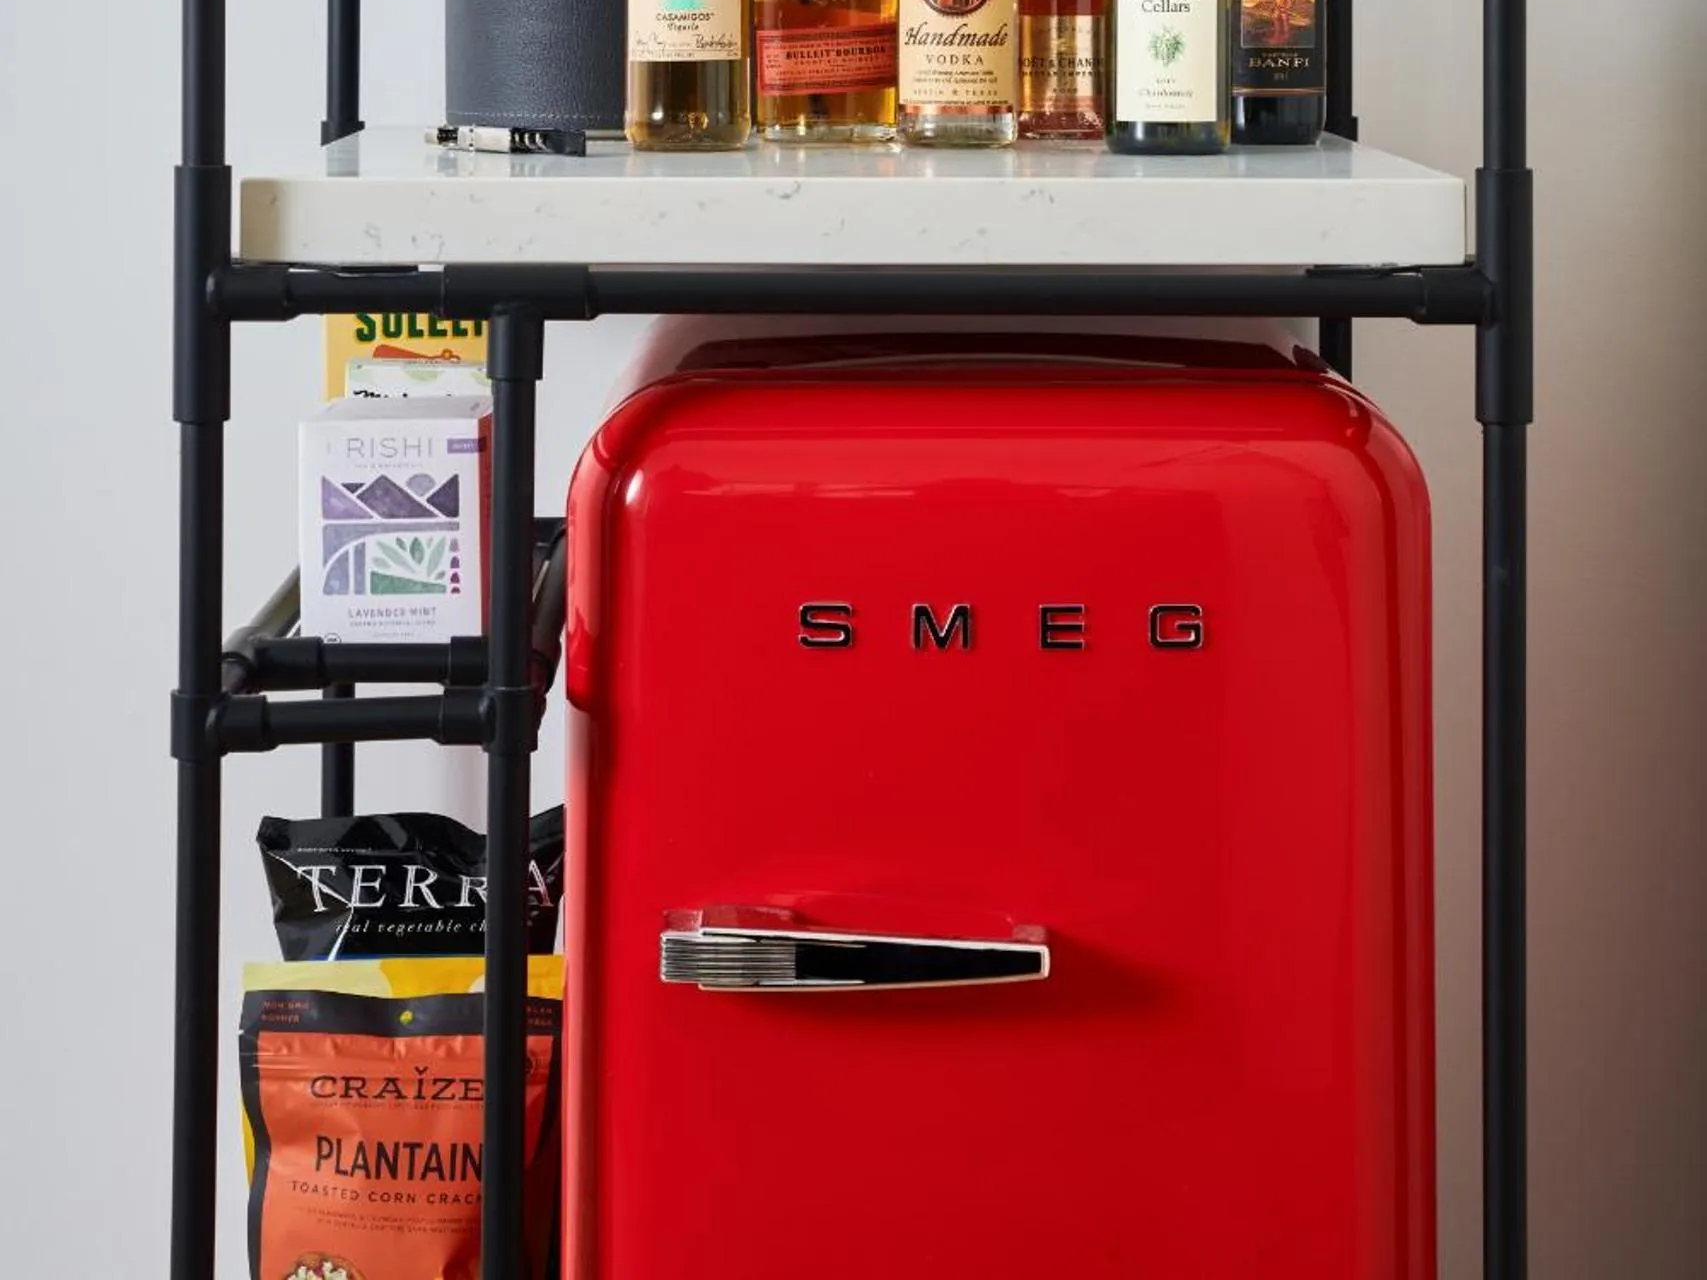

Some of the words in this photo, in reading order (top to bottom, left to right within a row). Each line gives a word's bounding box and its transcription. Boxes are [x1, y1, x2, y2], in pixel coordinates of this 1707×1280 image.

[903, 21, 1008, 48] Handmade
[926, 53, 985, 66] VODKA
[1247, 56, 1310, 69] BANFI
[345, 436, 433, 459] RISHI
[347, 607, 405, 619] LAVENDER
[409, 606, 437, 618] MINT
[377, 919, 462, 937] vegetable
[314, 1134, 484, 1182] PLANTAIN
[290, 1180, 360, 1202] TOASTED
[367, 1191, 416, 1204] CORN
